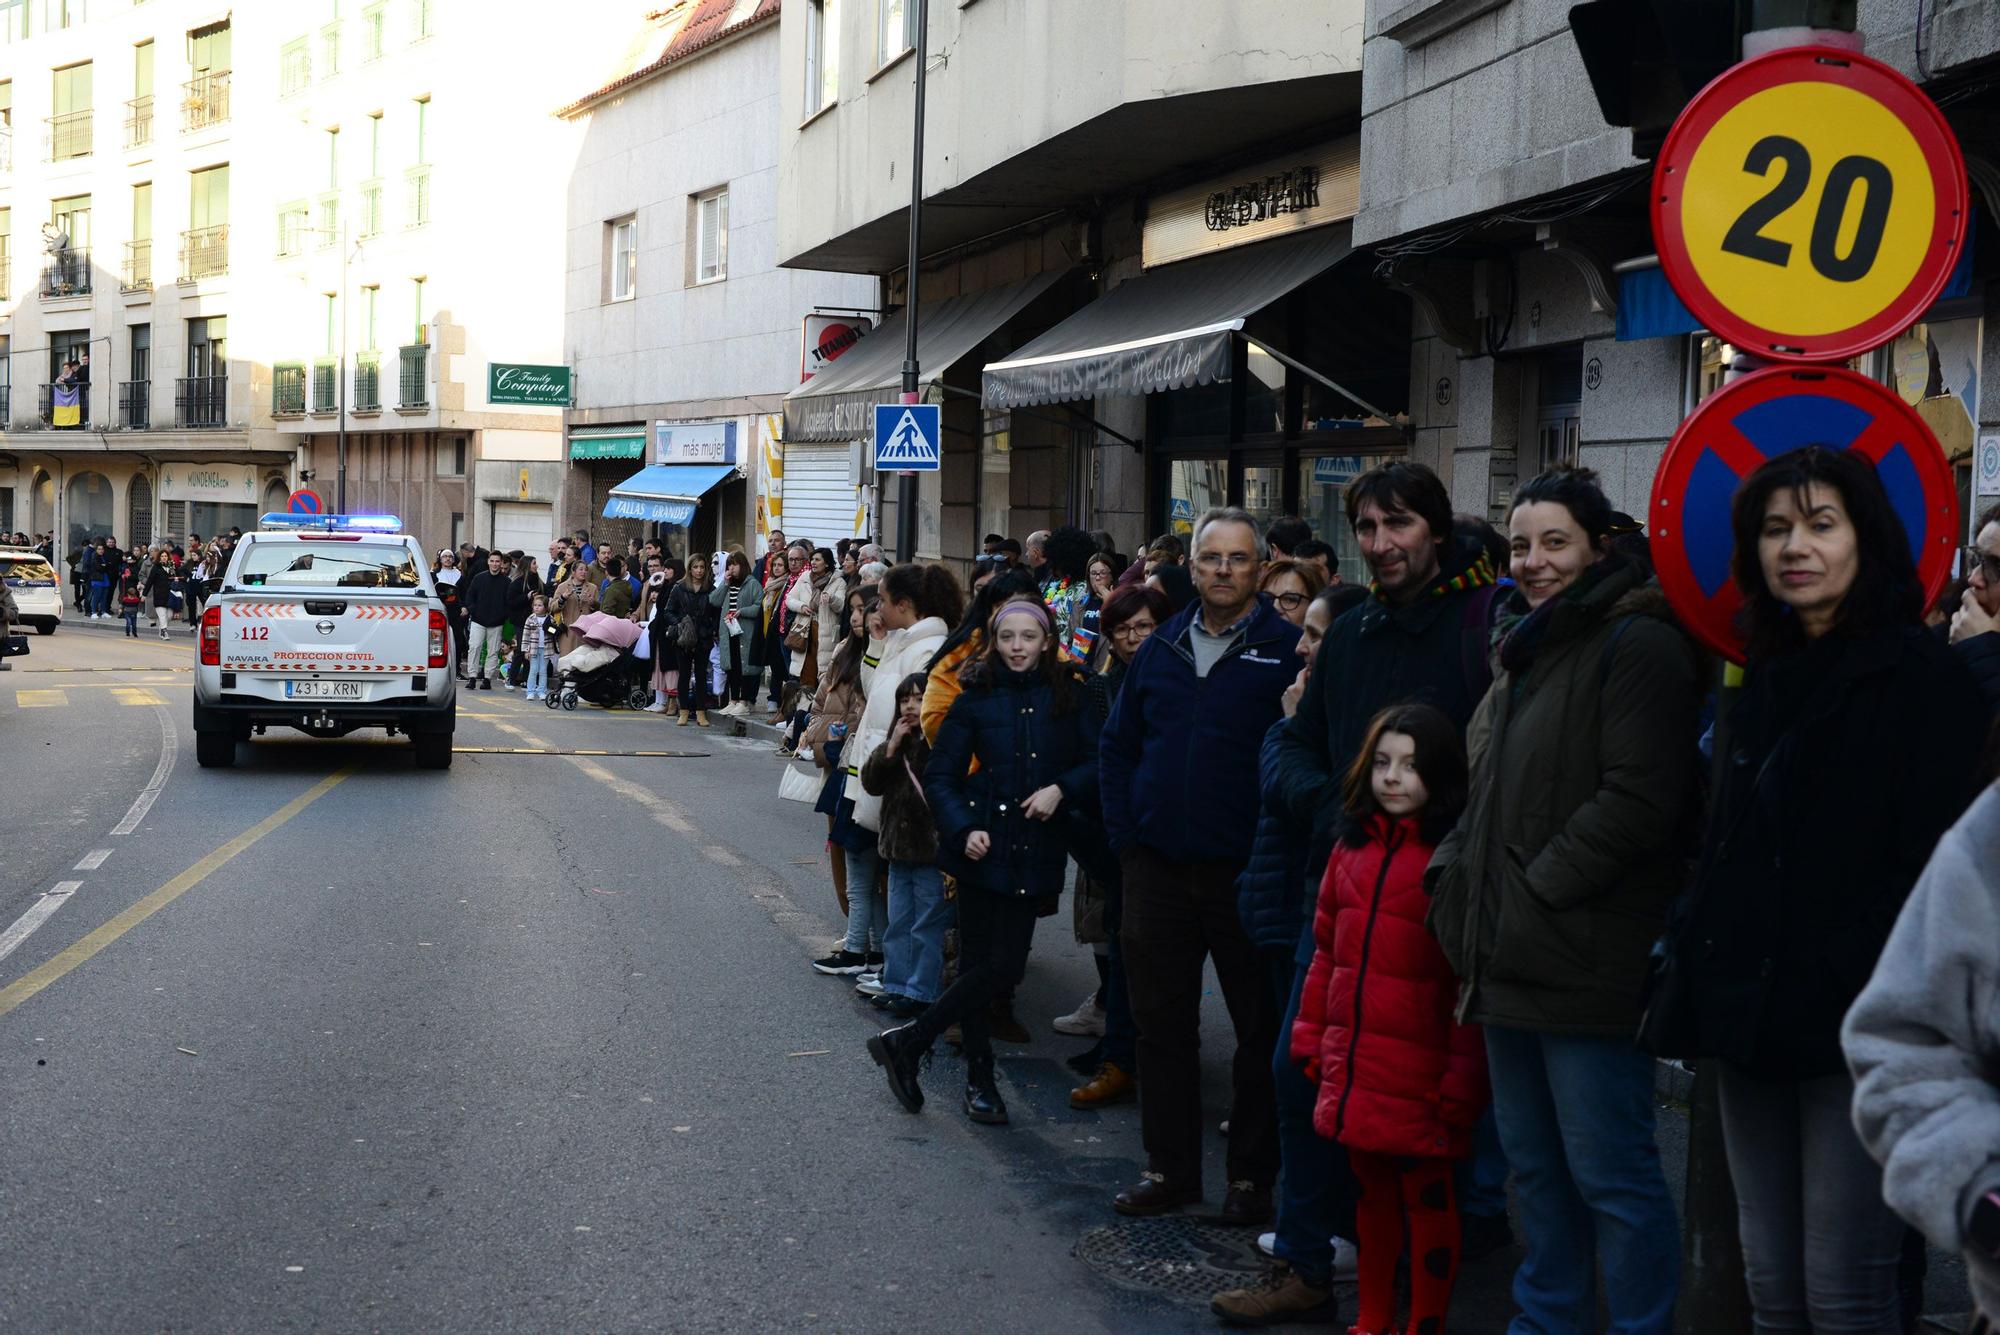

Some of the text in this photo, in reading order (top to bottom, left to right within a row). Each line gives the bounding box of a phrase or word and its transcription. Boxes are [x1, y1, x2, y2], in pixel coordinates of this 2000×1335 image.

[1721, 135, 1893, 282] 20
[497, 368, 565, 396] Company
[519, 371, 551, 383] Family
[1587, 365, 1600, 384] 89
[682, 438, 725, 460] más mujer
[616, 501, 691, 520] TALLAS GRANDES
[241, 627, 268, 640] 112
[227, 655, 269, 663] NAVARA
[345, 653, 375, 661] CIVIL
[295, 682, 359, 696] 4319 KRN
